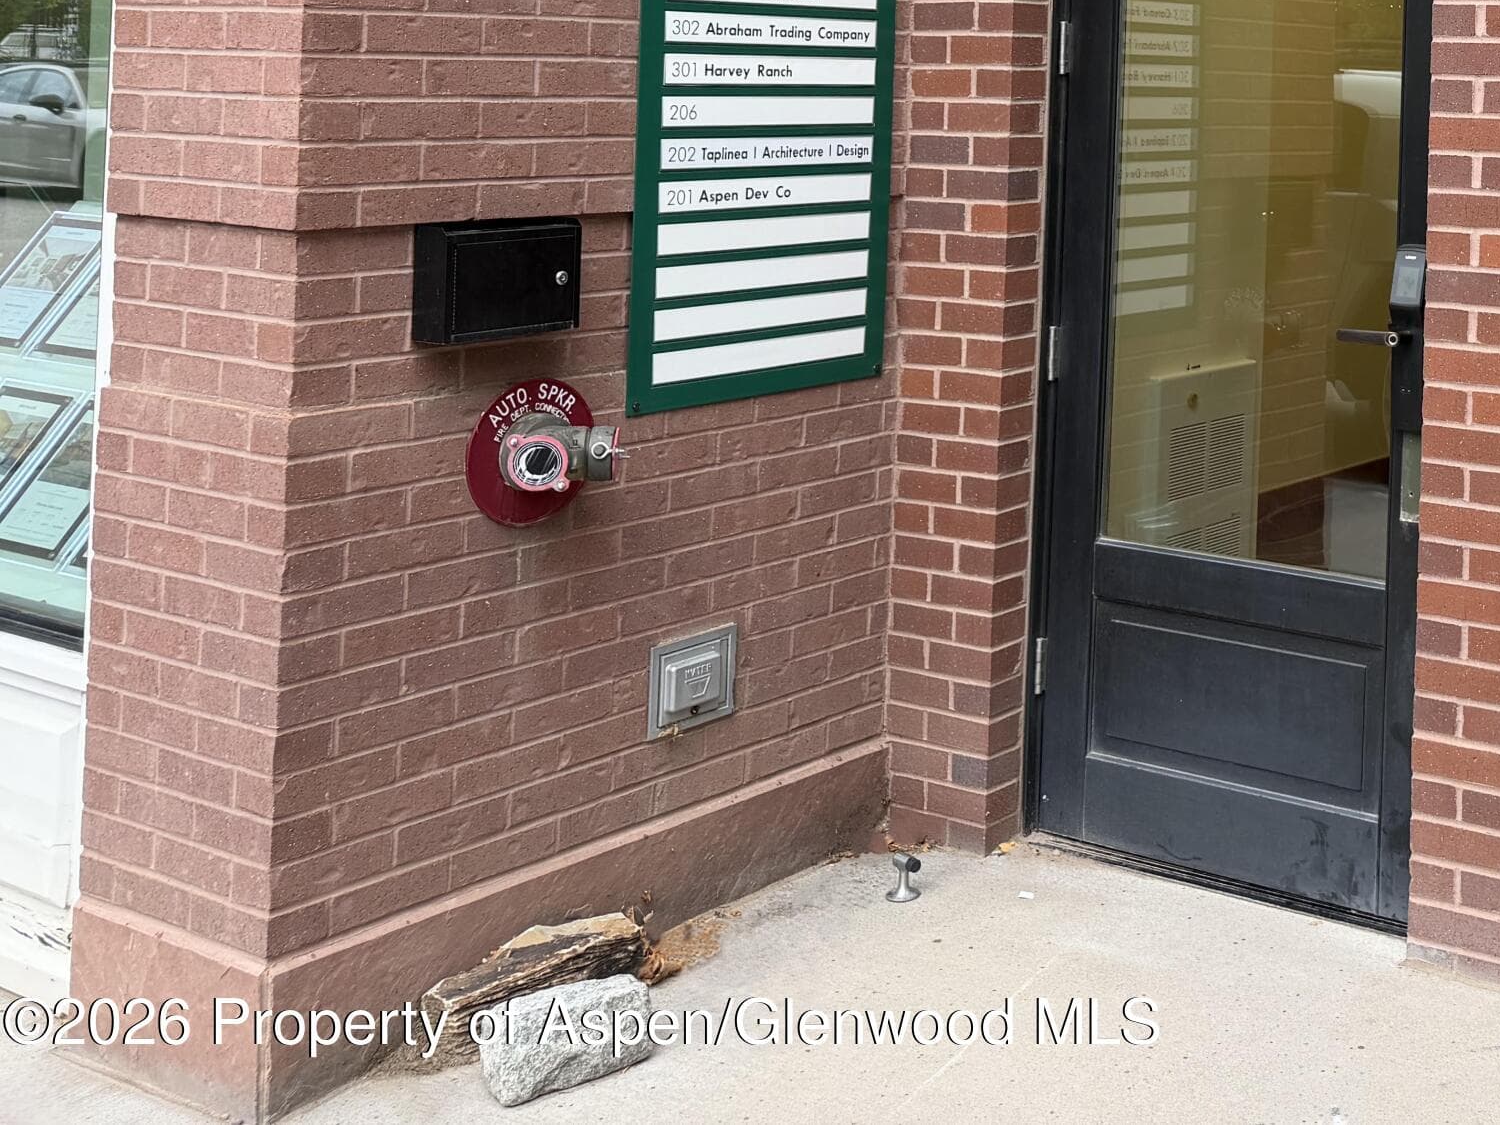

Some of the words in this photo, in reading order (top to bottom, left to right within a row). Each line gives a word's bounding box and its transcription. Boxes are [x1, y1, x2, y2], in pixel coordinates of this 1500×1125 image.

[671, 19, 700, 36] 302
[705, 22, 763, 38] Abraham
[769, 25, 812, 41] Trading
[817, 27, 871, 43] Company
[671, 62, 698, 78] 301
[704, 64, 751, 80] Harvey
[757, 65, 793, 78] Ranch
[669, 105, 698, 121] 206
[668, 147, 696, 163] 202
[701, 147, 748, 163] Taplinea
[762, 144, 824, 159] Architecture
[836, 144, 869, 158] Design
[667, 190, 693, 206] 201
[698, 189, 739, 204] Aspen
[745, 187, 769, 200] Dev
[775, 186, 791, 198] Co
[489, 387, 532, 428] AUTO.
[538, 383, 576, 415] SPKR.
[493, 423, 510, 444] FIRE
[511, 404, 532, 422] DEPT.
